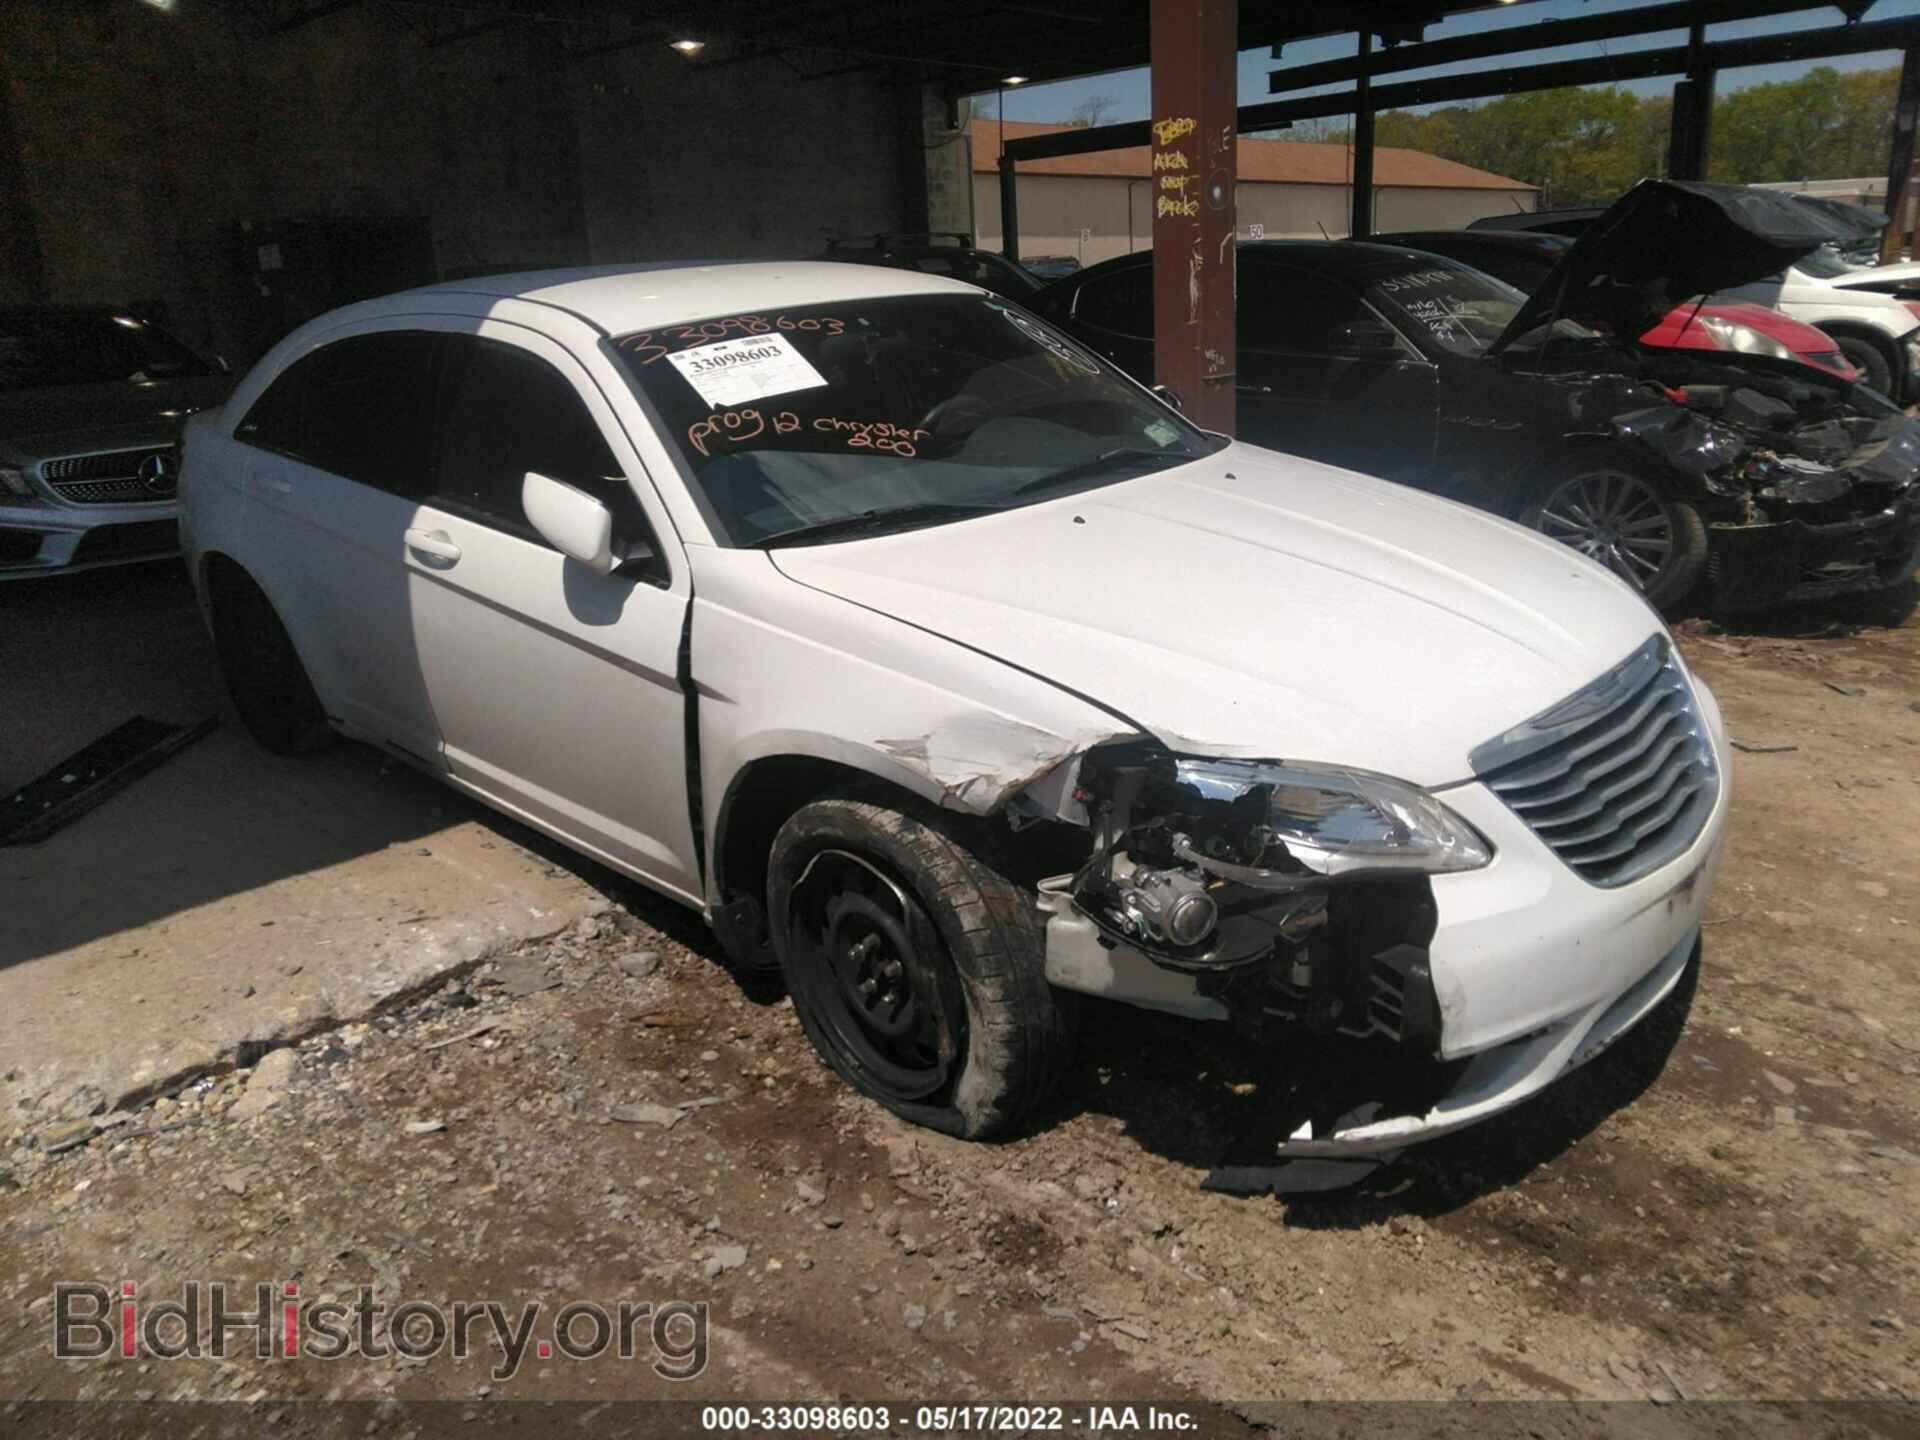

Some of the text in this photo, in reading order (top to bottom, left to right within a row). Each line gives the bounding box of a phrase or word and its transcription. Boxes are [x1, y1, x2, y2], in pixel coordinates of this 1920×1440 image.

[619, 314, 845, 365] 33098603
[690, 345, 783, 374] 33098603
[688, 409, 764, 456] prog
[773, 412, 801, 434] 12
[848, 432, 916, 457] 200
